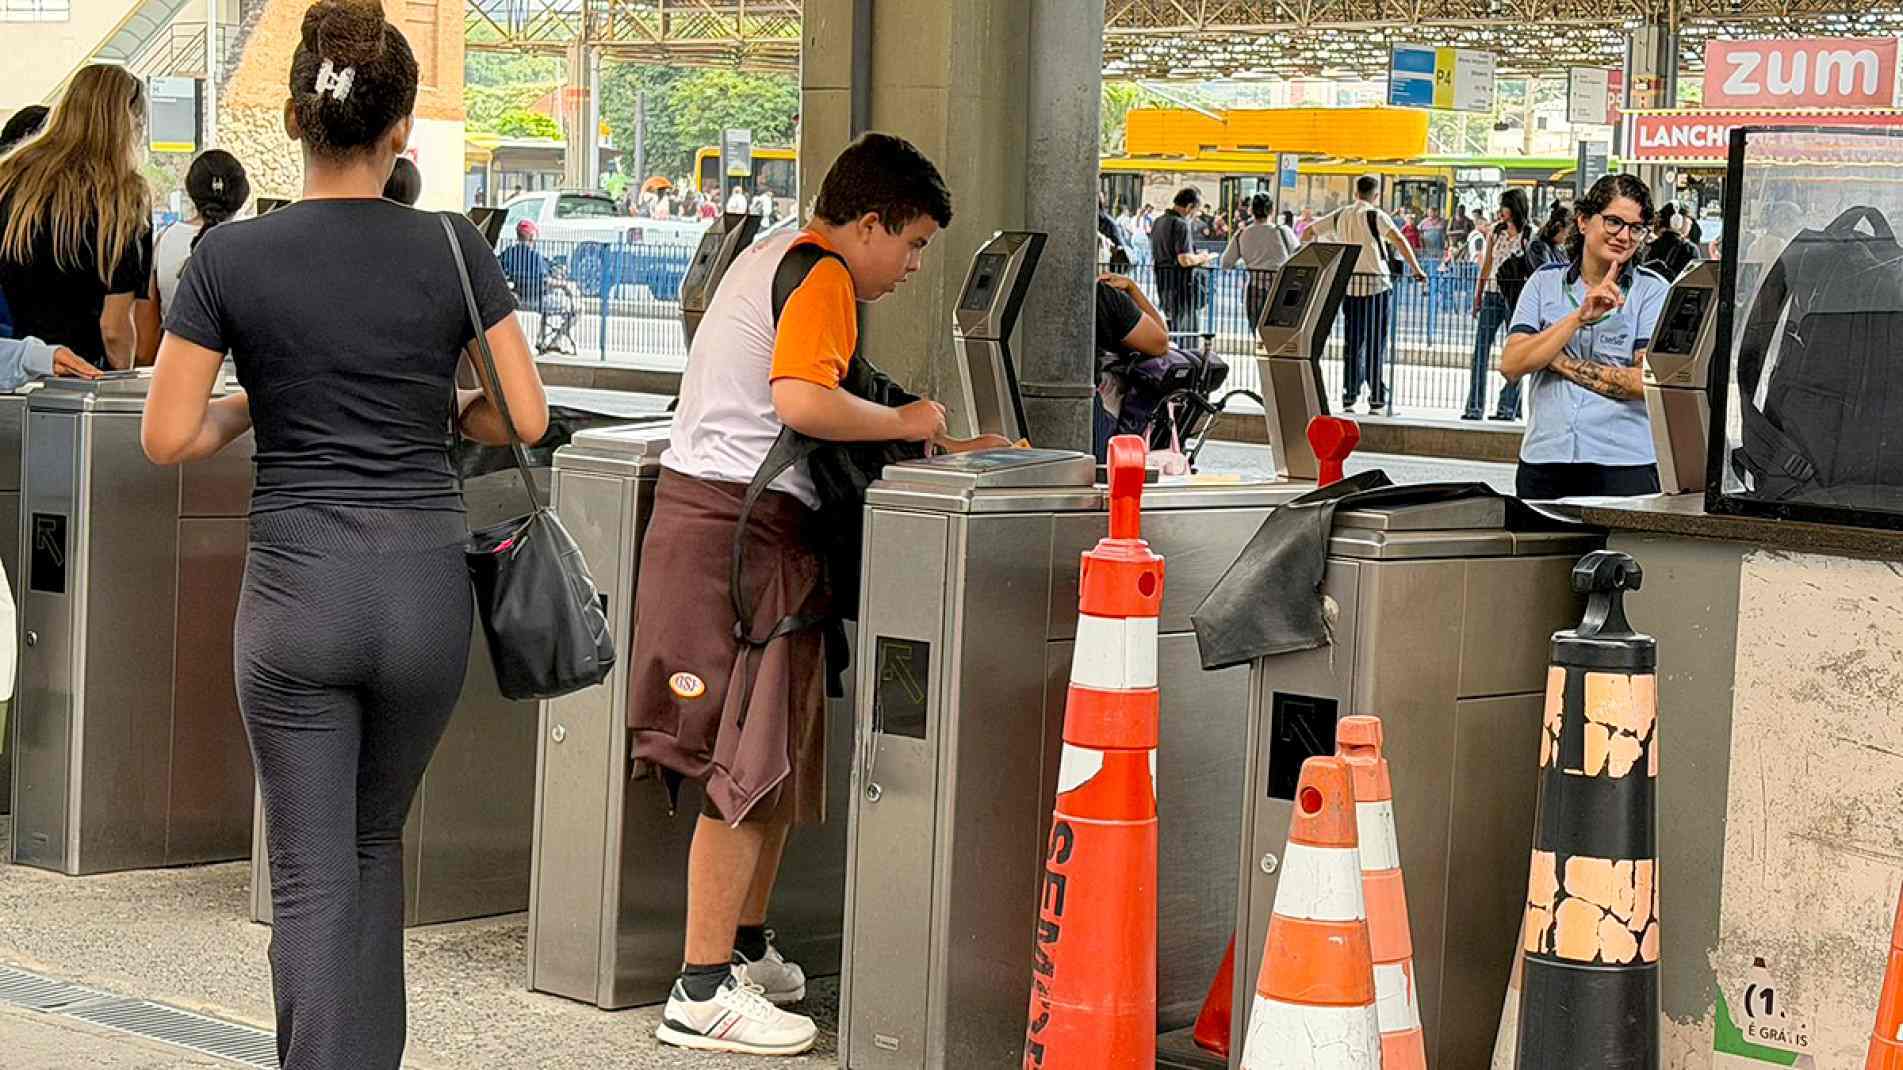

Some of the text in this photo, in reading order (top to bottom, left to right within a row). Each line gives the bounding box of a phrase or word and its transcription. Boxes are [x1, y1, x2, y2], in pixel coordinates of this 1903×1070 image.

[1436, 68, 1451, 87] P4
[1722, 49, 1880, 96] zum
[1748, 1022, 1809, 1047] É GRÁIS
